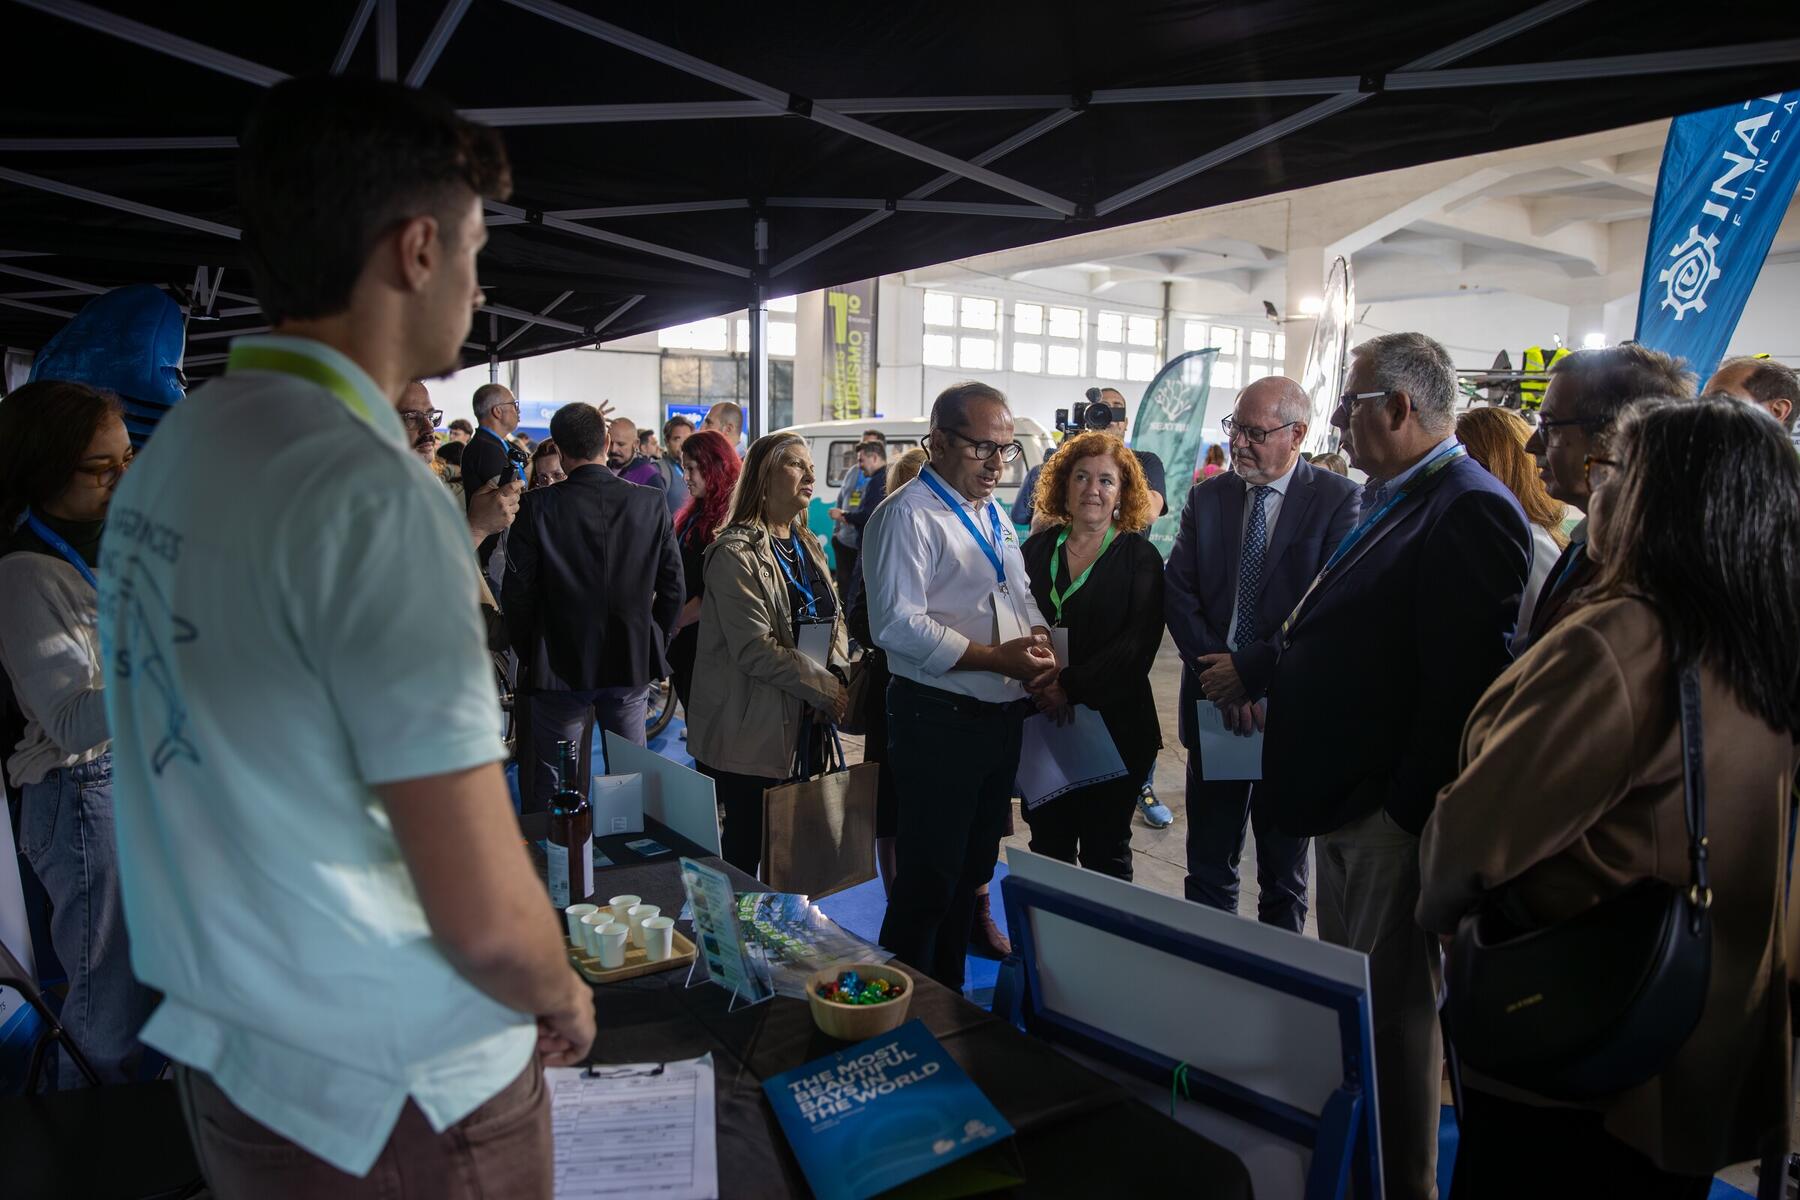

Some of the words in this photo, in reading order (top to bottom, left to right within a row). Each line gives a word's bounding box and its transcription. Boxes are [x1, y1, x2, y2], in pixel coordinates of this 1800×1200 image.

[846, 330, 862, 419] TURISMO
[788, 1070, 834, 1093] THE
[836, 1042, 899, 1076] MOST
[794, 1050, 917, 1103] BEAUTIFUL
[799, 1083, 859, 1114] BAYS
[860, 1072, 888, 1090] IN
[803, 1098, 852, 1124] THE
[853, 1062, 941, 1104] WORLD
